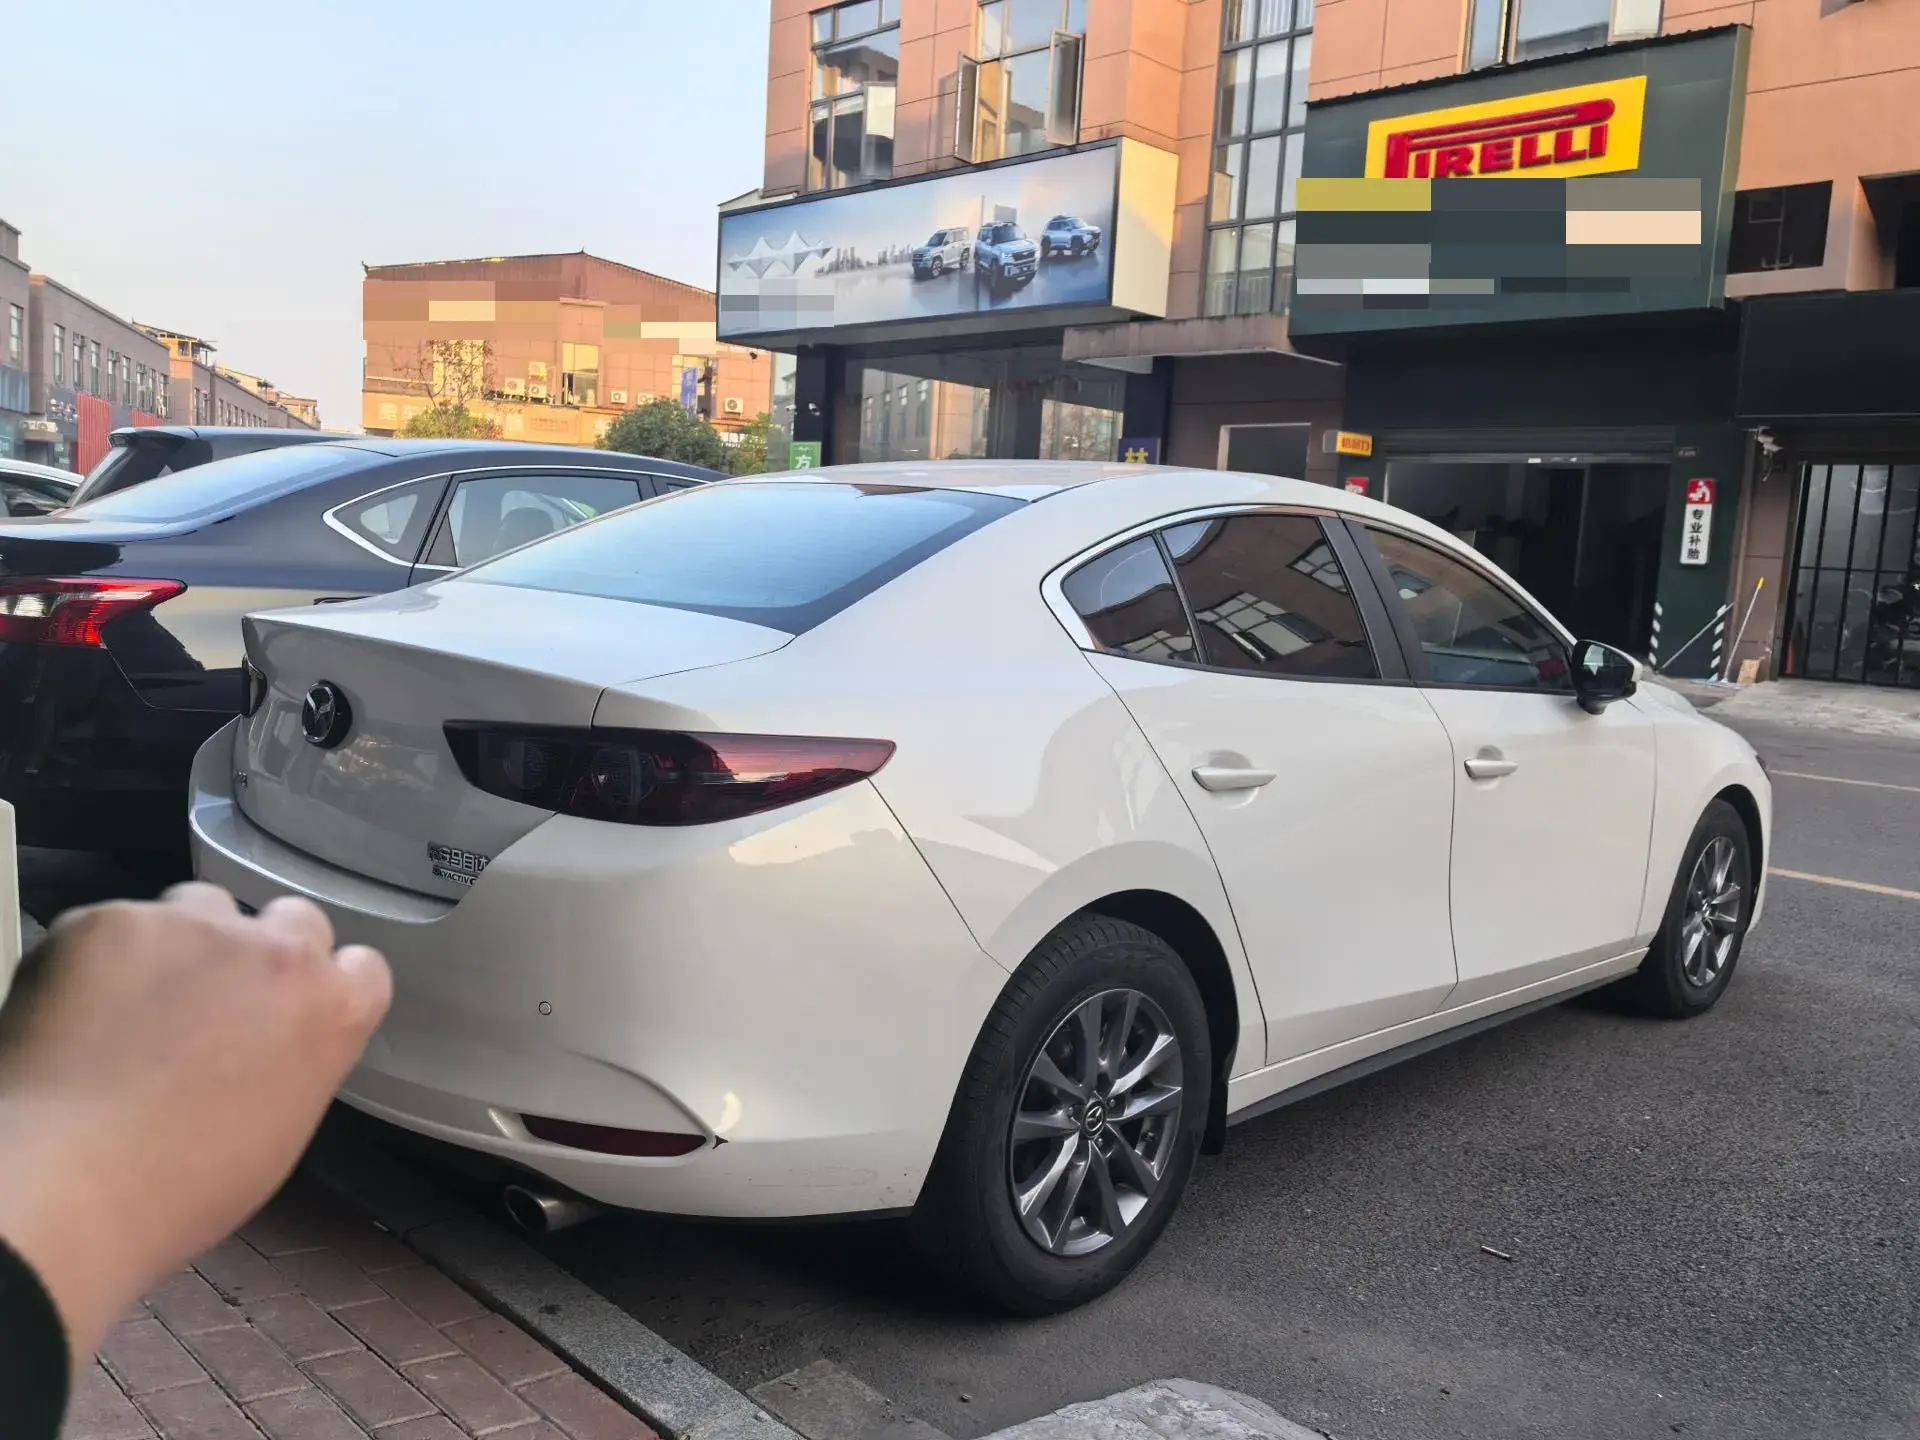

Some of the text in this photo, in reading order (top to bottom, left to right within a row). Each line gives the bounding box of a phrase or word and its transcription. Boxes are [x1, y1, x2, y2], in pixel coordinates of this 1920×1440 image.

[1385, 98, 1615, 178] PIRELLI
[1687, 508, 1704, 560] 专业补胎
[430, 846, 490, 872] 马自达
[433, 867, 469, 885] KYACTIV
